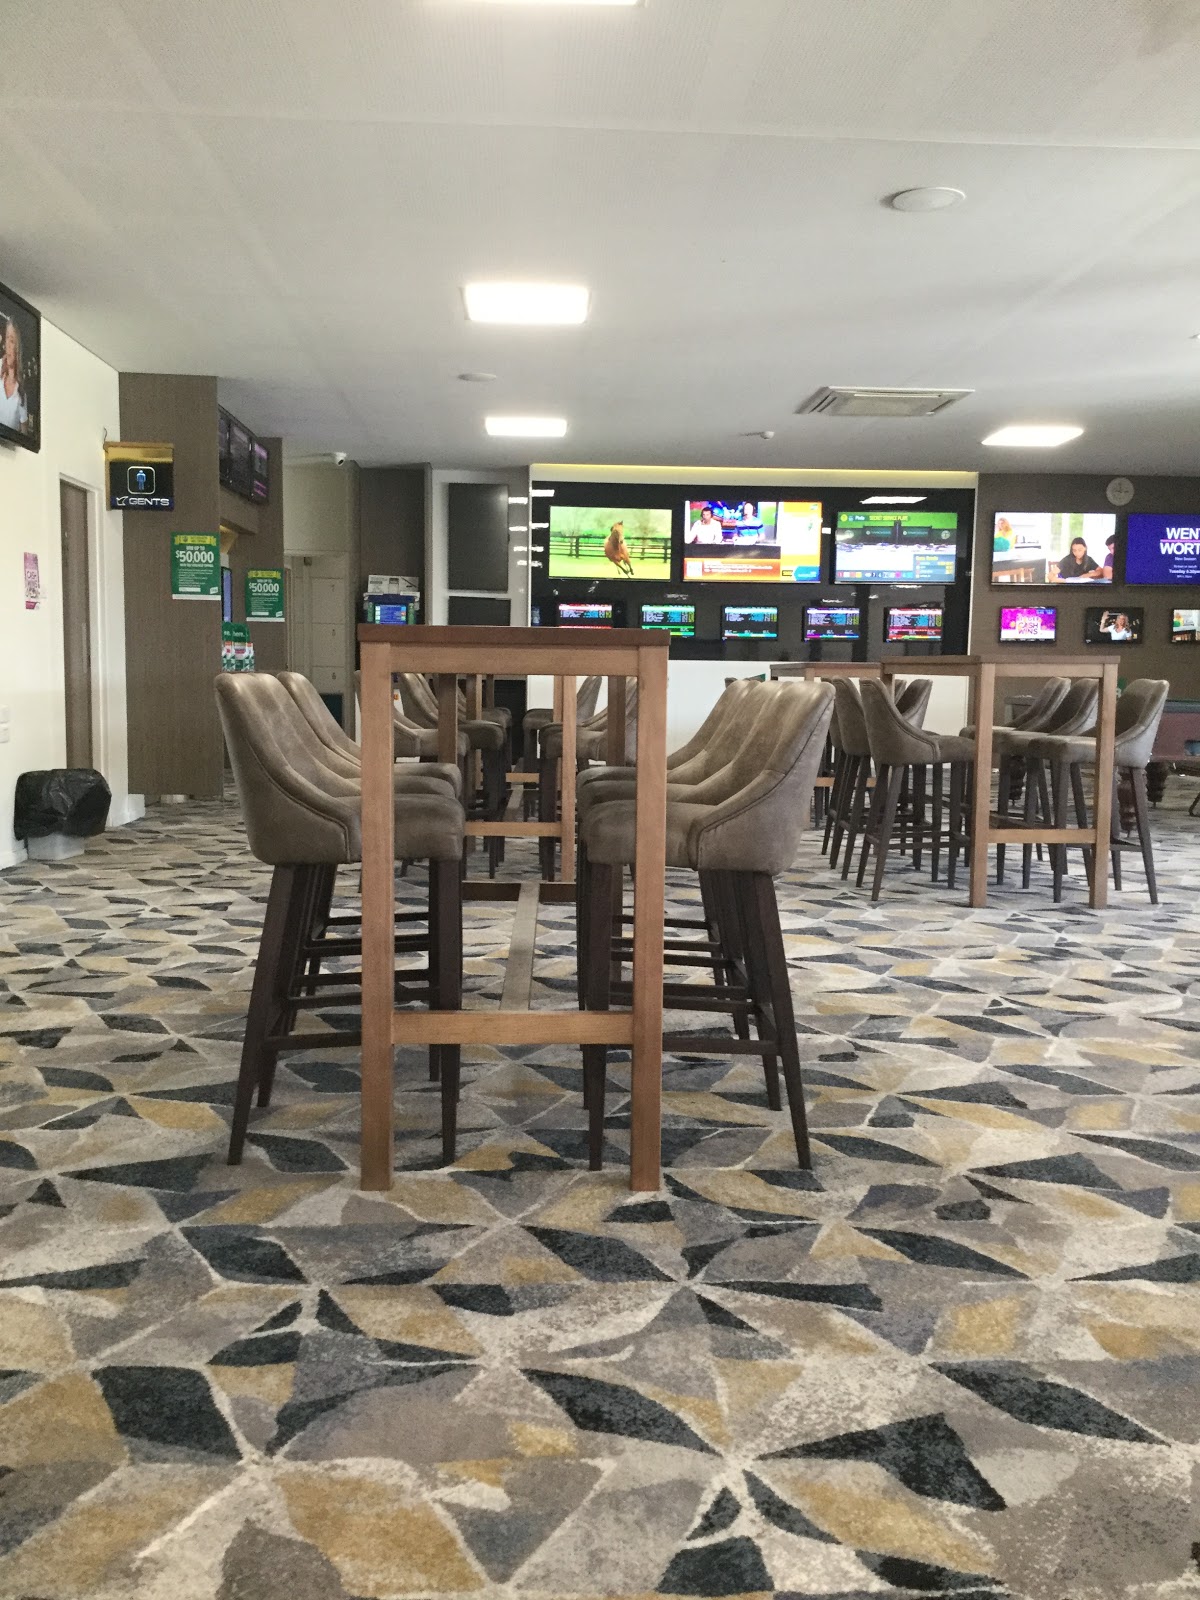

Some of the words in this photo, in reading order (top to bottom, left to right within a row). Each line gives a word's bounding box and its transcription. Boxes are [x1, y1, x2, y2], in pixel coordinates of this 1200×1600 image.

[129, 497, 170, 506] GENTS
[1166, 527, 1200, 540] WEN
[175, 550, 215, 563] $50,000
